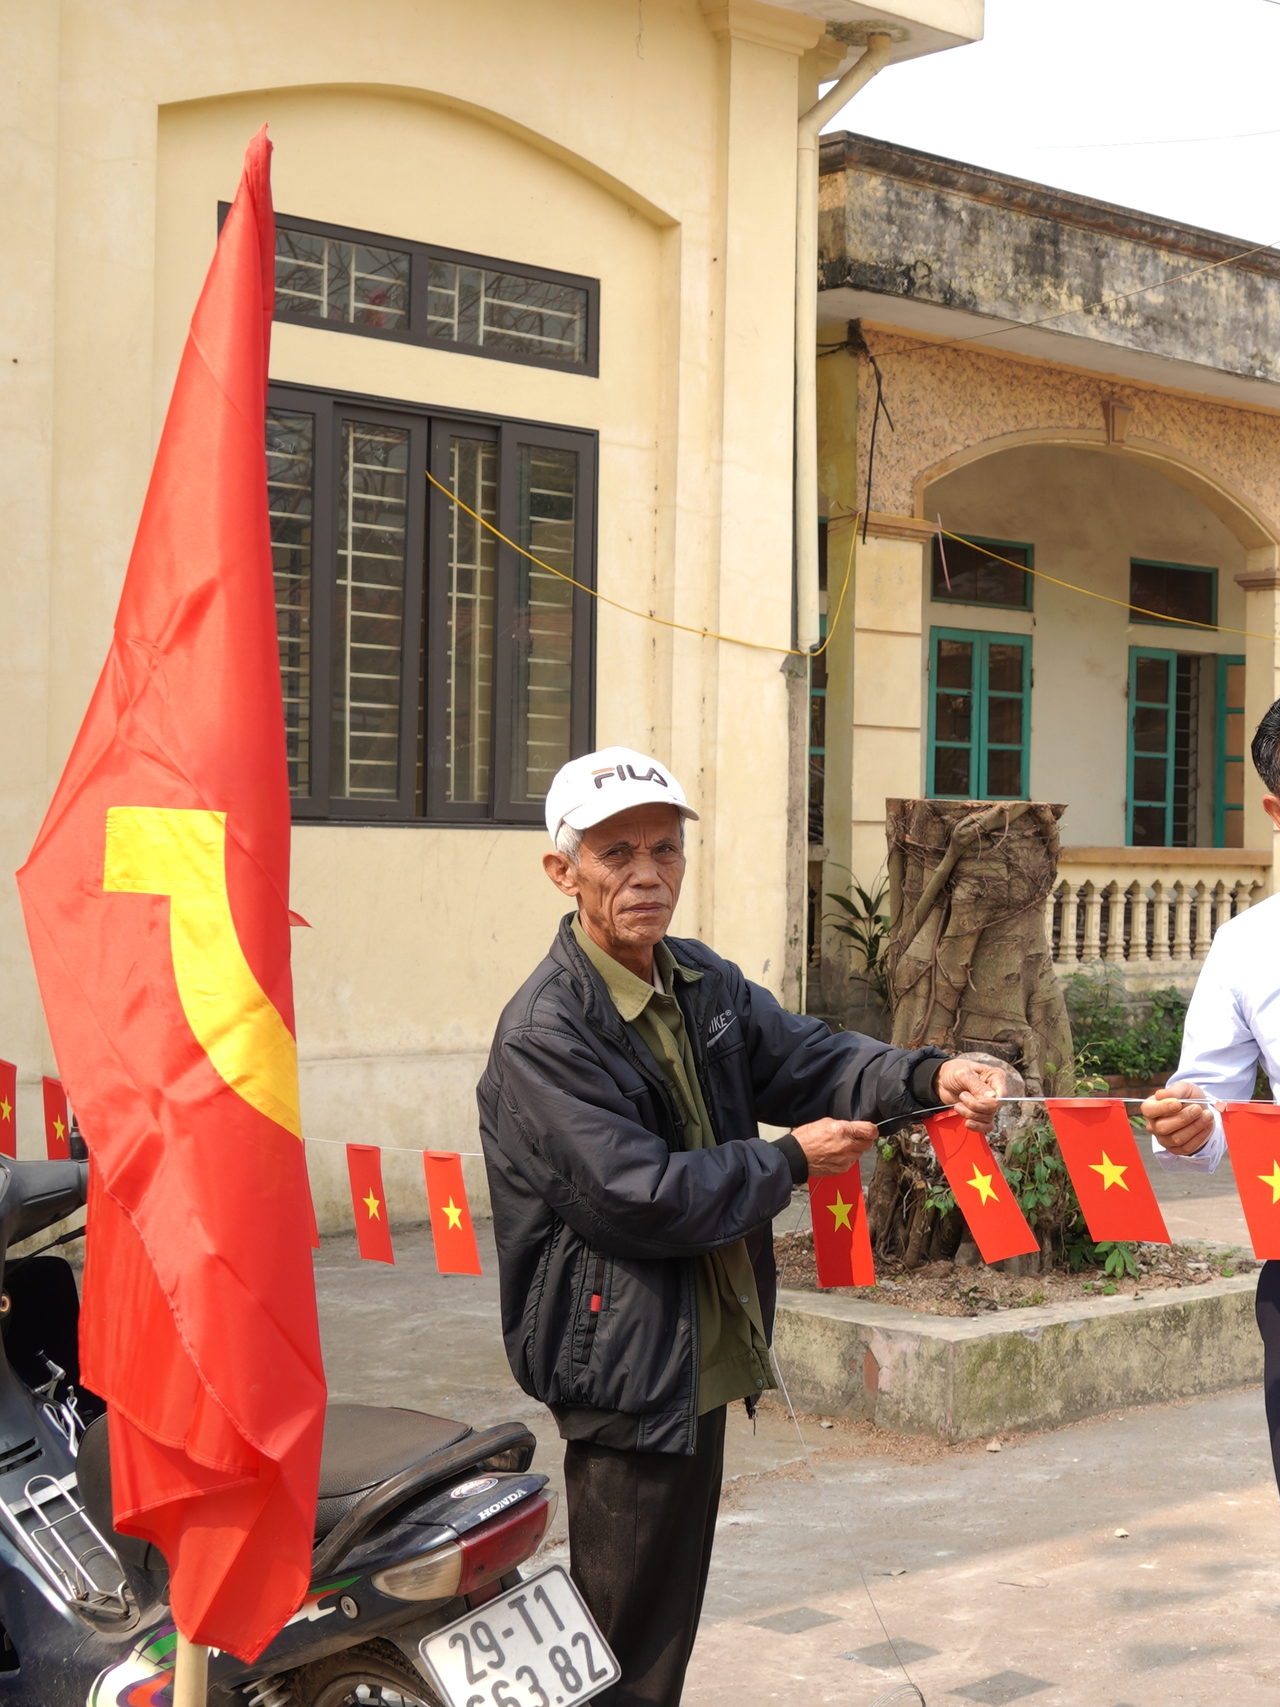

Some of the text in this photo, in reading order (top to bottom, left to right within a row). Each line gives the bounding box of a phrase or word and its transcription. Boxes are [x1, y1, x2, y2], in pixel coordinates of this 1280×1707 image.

[591, 764, 668, 789] FILA
[478, 1488, 528, 1520] HONDA
[449, 1584, 566, 1686] 29-T1
[466, 1631, 608, 1707] 63.82
